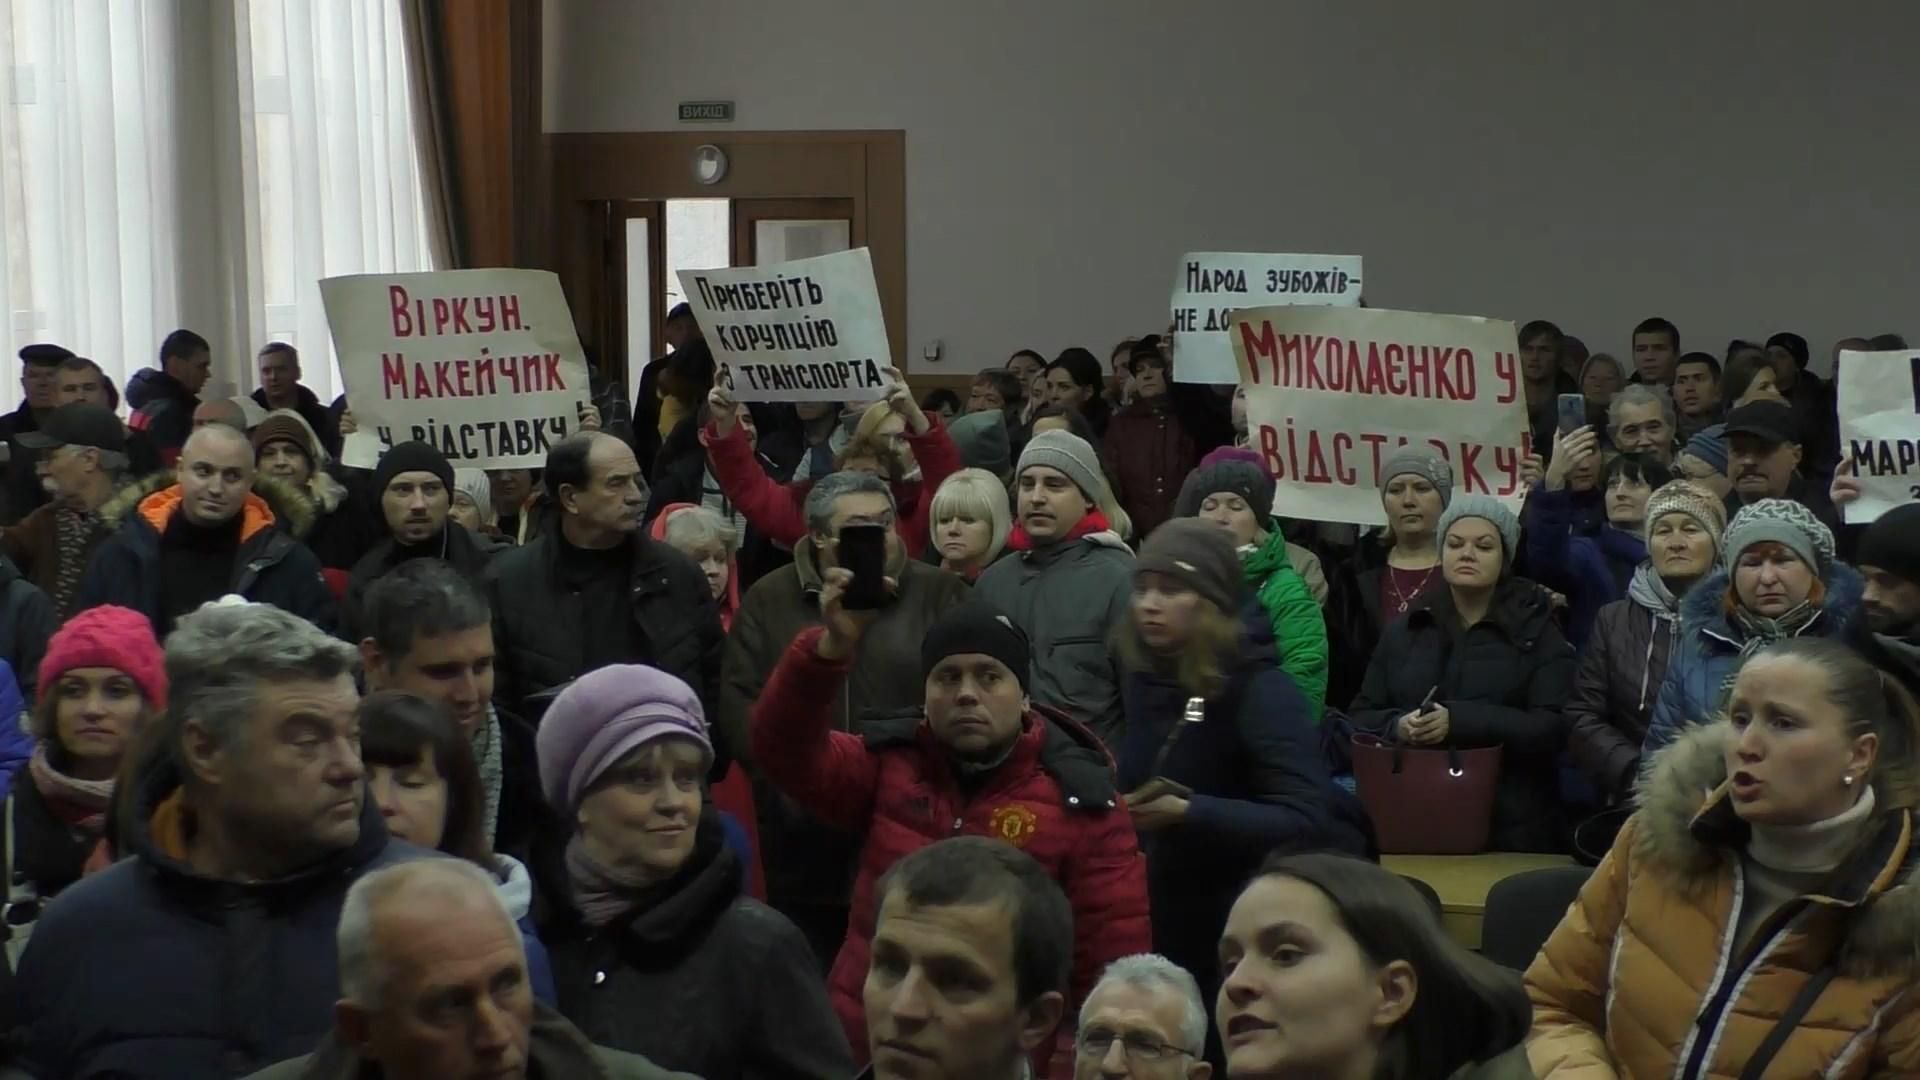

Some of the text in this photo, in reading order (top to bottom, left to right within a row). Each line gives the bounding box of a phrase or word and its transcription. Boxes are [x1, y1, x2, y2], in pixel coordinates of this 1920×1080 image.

[682, 105, 725, 118] ВИХІД
[695, 274, 824, 312] ПРИБЕРІТЬ
[1186, 262, 1248, 293] НАРОД
[715, 315, 839, 352] КОРУПЦІЮ
[1174, 308, 1197, 332] НЕ
[382, 347, 567, 400] МАКЕЙЧИК
[740, 358, 883, 391] ТРАНСПОРТА
[1239, 320, 1517, 404] МИКОЛАЄНКО У
[1259, 417, 1532, 500] ВІДСТКУ!
[1851, 439, 1920, 477] МАР
